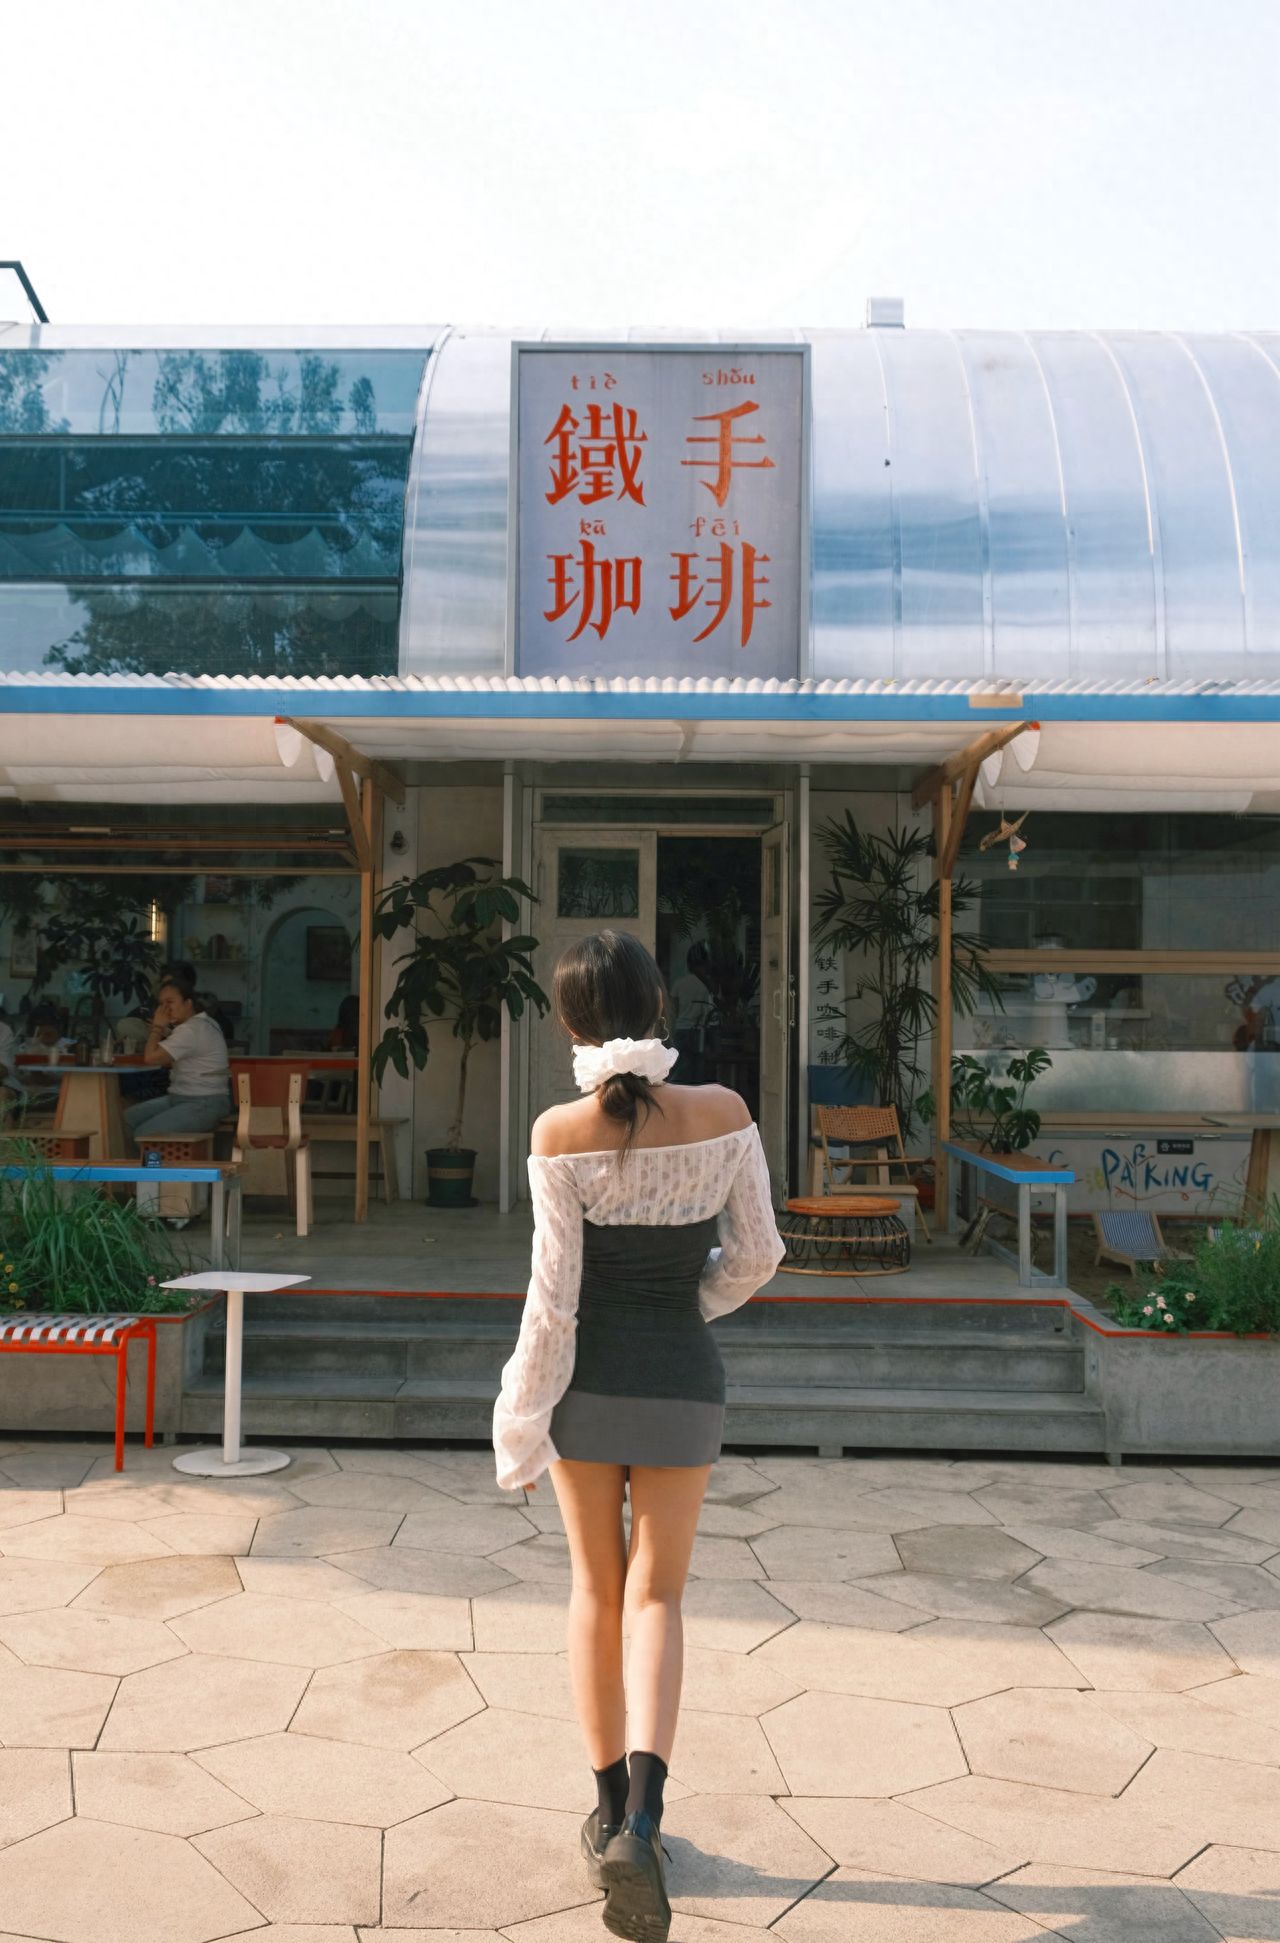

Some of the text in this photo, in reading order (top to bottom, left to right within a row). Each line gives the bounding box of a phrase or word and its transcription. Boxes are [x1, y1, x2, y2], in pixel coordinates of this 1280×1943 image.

[571, 372, 617, 390] tiè
[544, 400, 775, 508] 鐵手
[579, 516, 741, 537] kā fēi
[542, 539, 772, 648] 珈琲
